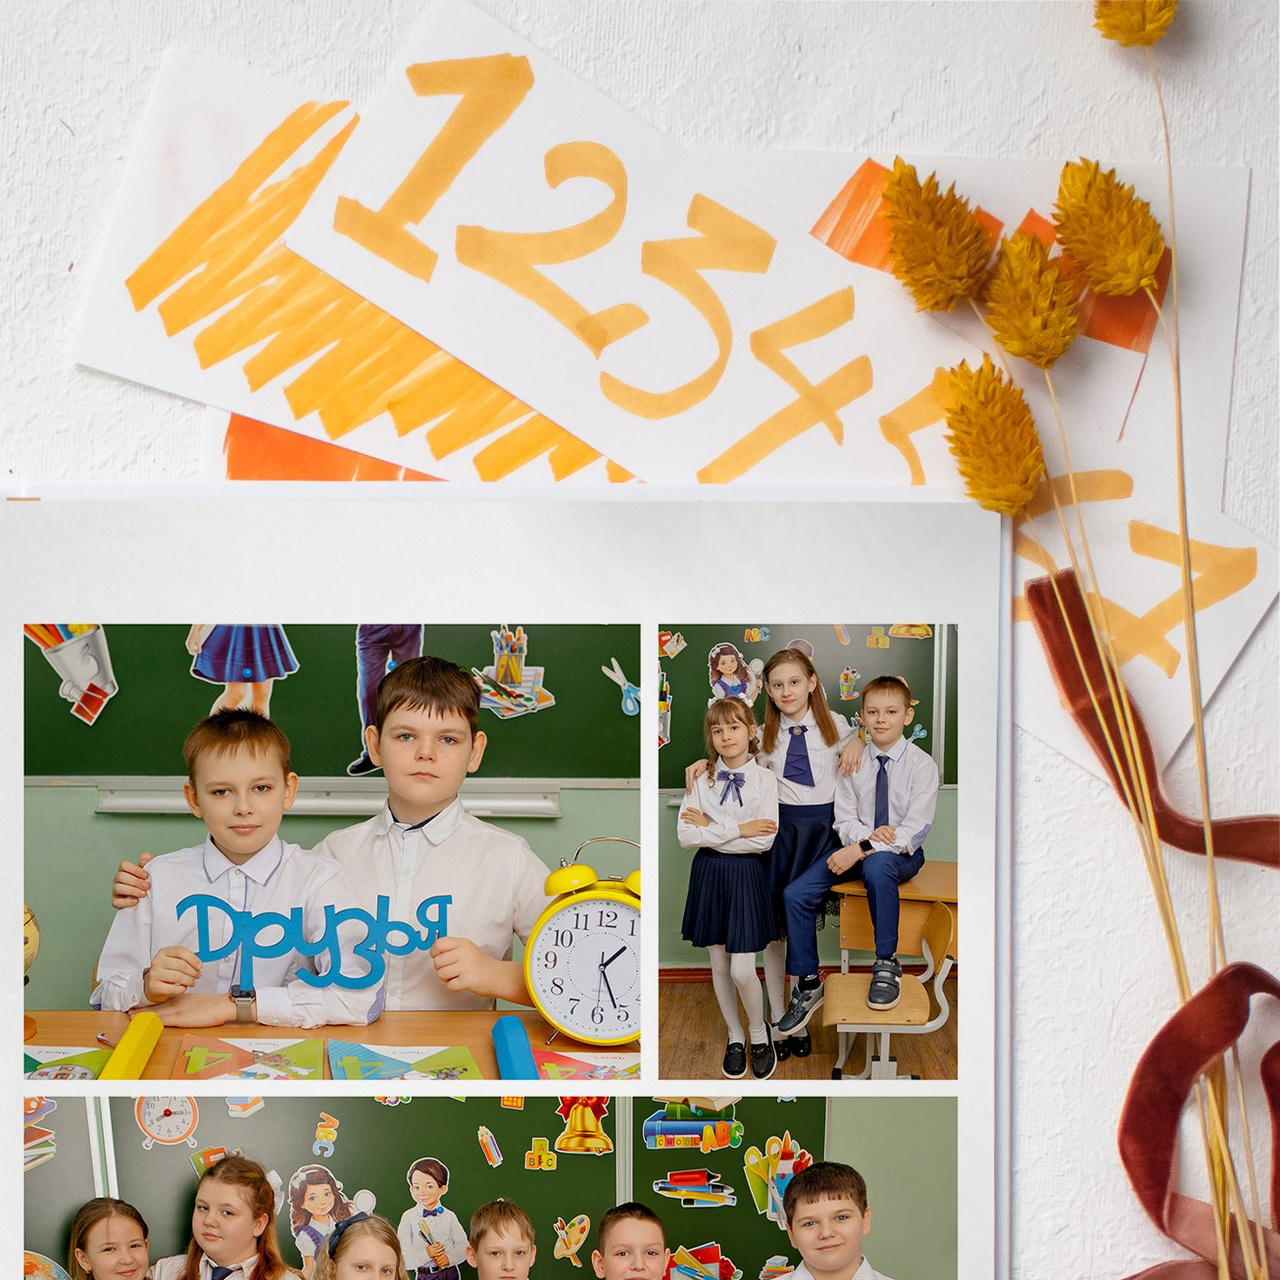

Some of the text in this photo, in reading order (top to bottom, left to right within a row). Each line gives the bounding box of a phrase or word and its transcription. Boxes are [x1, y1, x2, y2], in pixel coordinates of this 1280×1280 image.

[743, 626, 771, 643] ABC
[573, 912, 590, 931] 11
[597, 909, 619, 929] 12
[629, 919, 637, 937] 1
[175, 893, 454, 991] Друзья
[553, 928, 574, 949] 10
[543, 950, 558, 970] 9
[550, 977, 565, 996] 8
[569, 997, 581, 1016] 7
[590, 1005, 604, 1025] 6
[616, 1003, 630, 1022] 5
[312, 1111, 340, 1158] ABC
[700, 1120, 745, 1154] ABC
